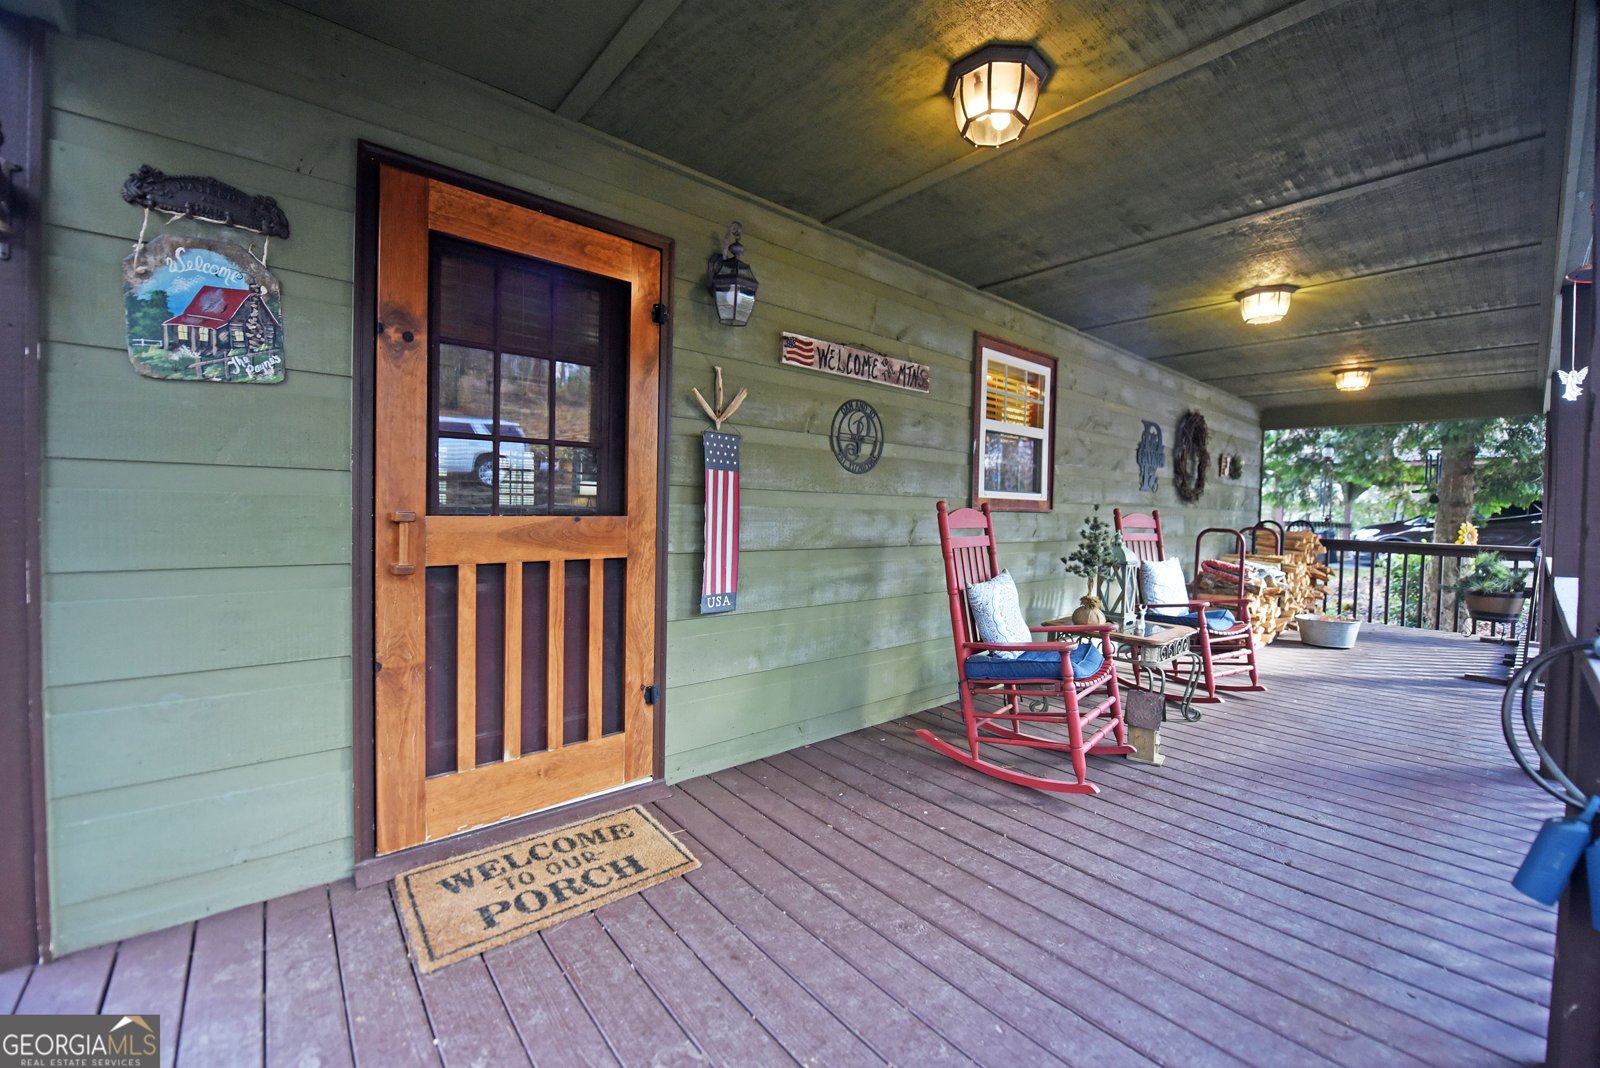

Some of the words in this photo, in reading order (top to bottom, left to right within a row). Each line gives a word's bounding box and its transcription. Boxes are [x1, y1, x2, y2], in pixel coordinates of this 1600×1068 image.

[166, 246, 244, 286] Welcome
[227, 355, 250, 375] The
[816, 343, 879, 380] WELCOME
[881, 359, 889, 368] TO
[882, 366, 896, 382] THE
[897, 363, 927, 388] MTNS
[707, 595, 731, 608] USA
[435, 823, 636, 894] WELCOME
[473, 854, 650, 931] PORCH
